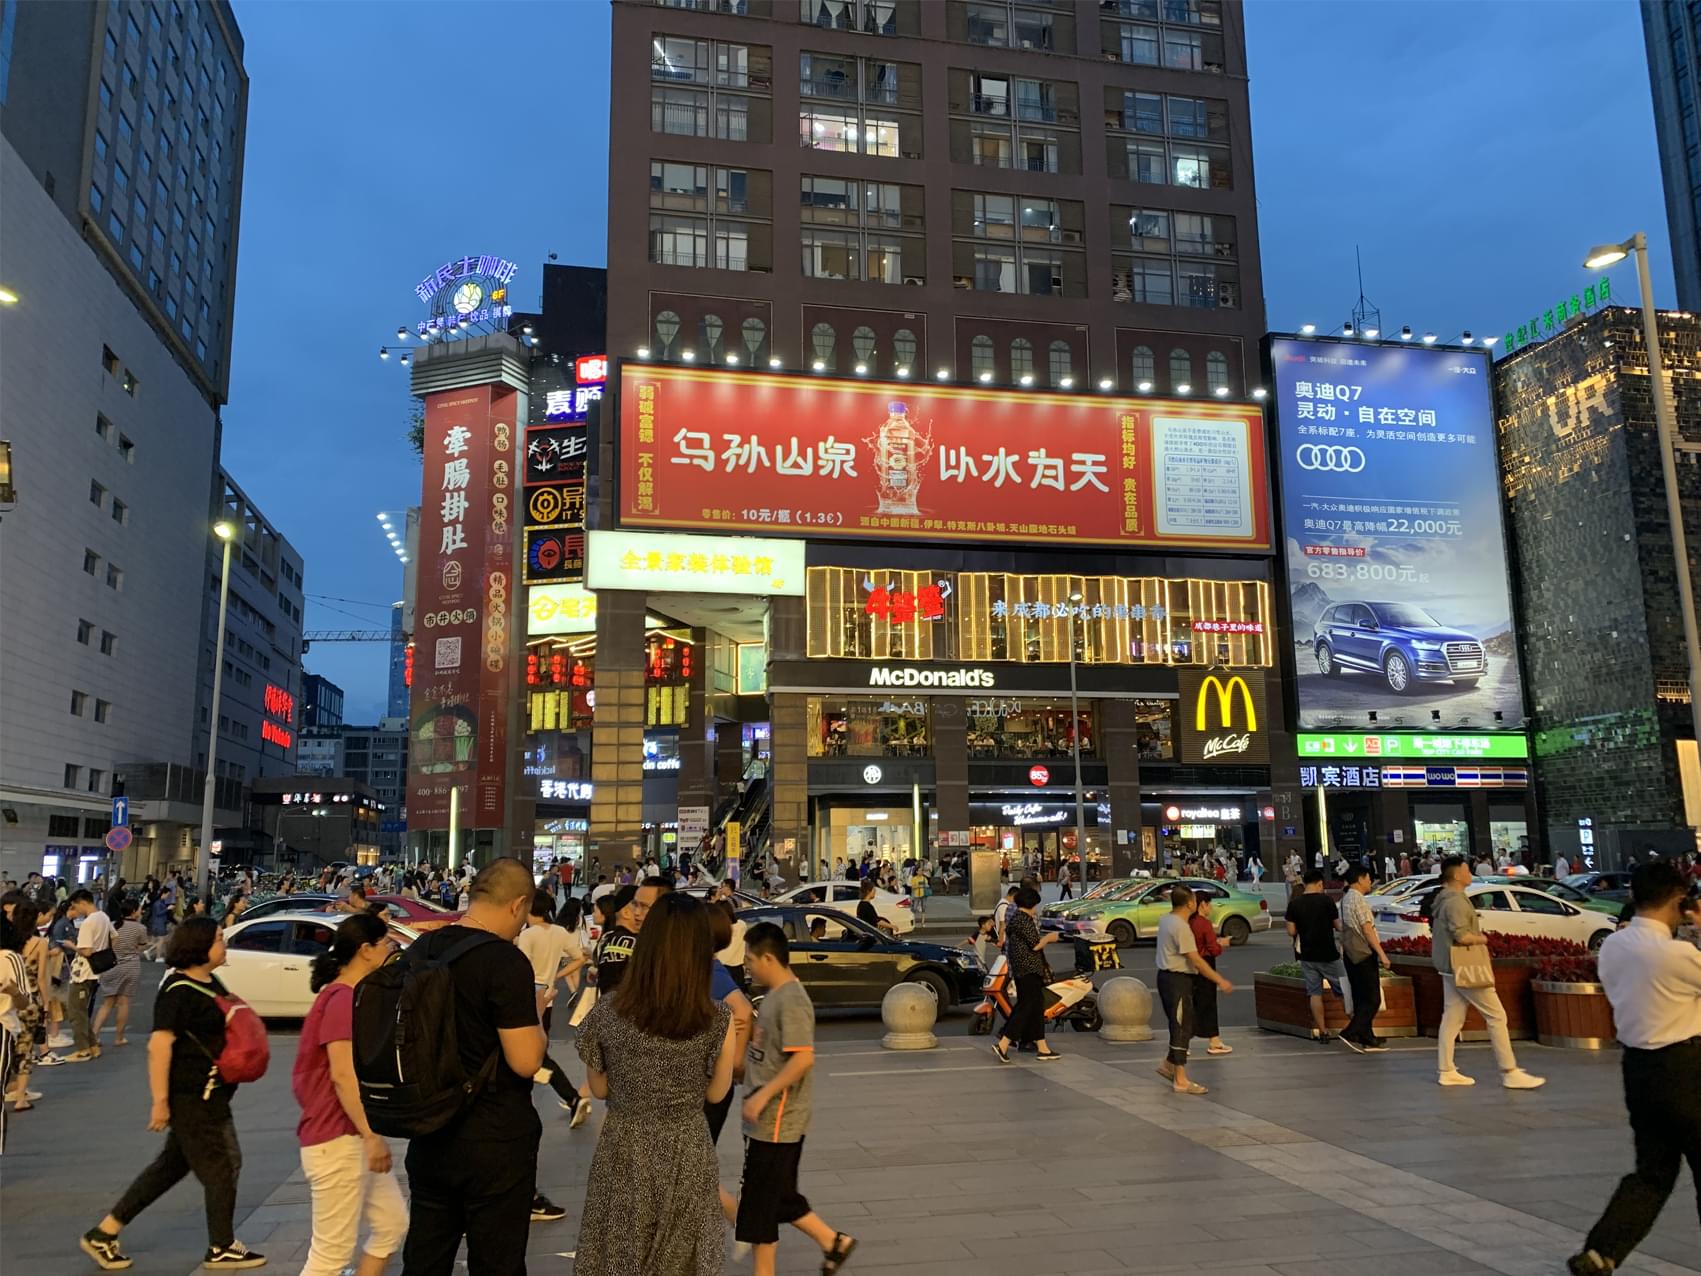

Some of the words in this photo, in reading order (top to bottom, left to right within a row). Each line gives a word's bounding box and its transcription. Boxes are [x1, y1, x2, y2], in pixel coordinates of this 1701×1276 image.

[1295, 381, 1362, 401] 奥迪Q7
[560, 436, 587, 460] 生
[671, 428, 858, 479] 乌孙山泉
[1121, 415, 1137, 470] 指标均好
[495, 462, 508, 487] 毛肚
[939, 445, 1110, 493] 以水为天
[869, 667, 994, 687] McDonald's
[1203, 733, 1250, 757] McCafé
[1300, 766, 1379, 787] 凯宾酒店
[540, 780, 593, 800] 香港代购
